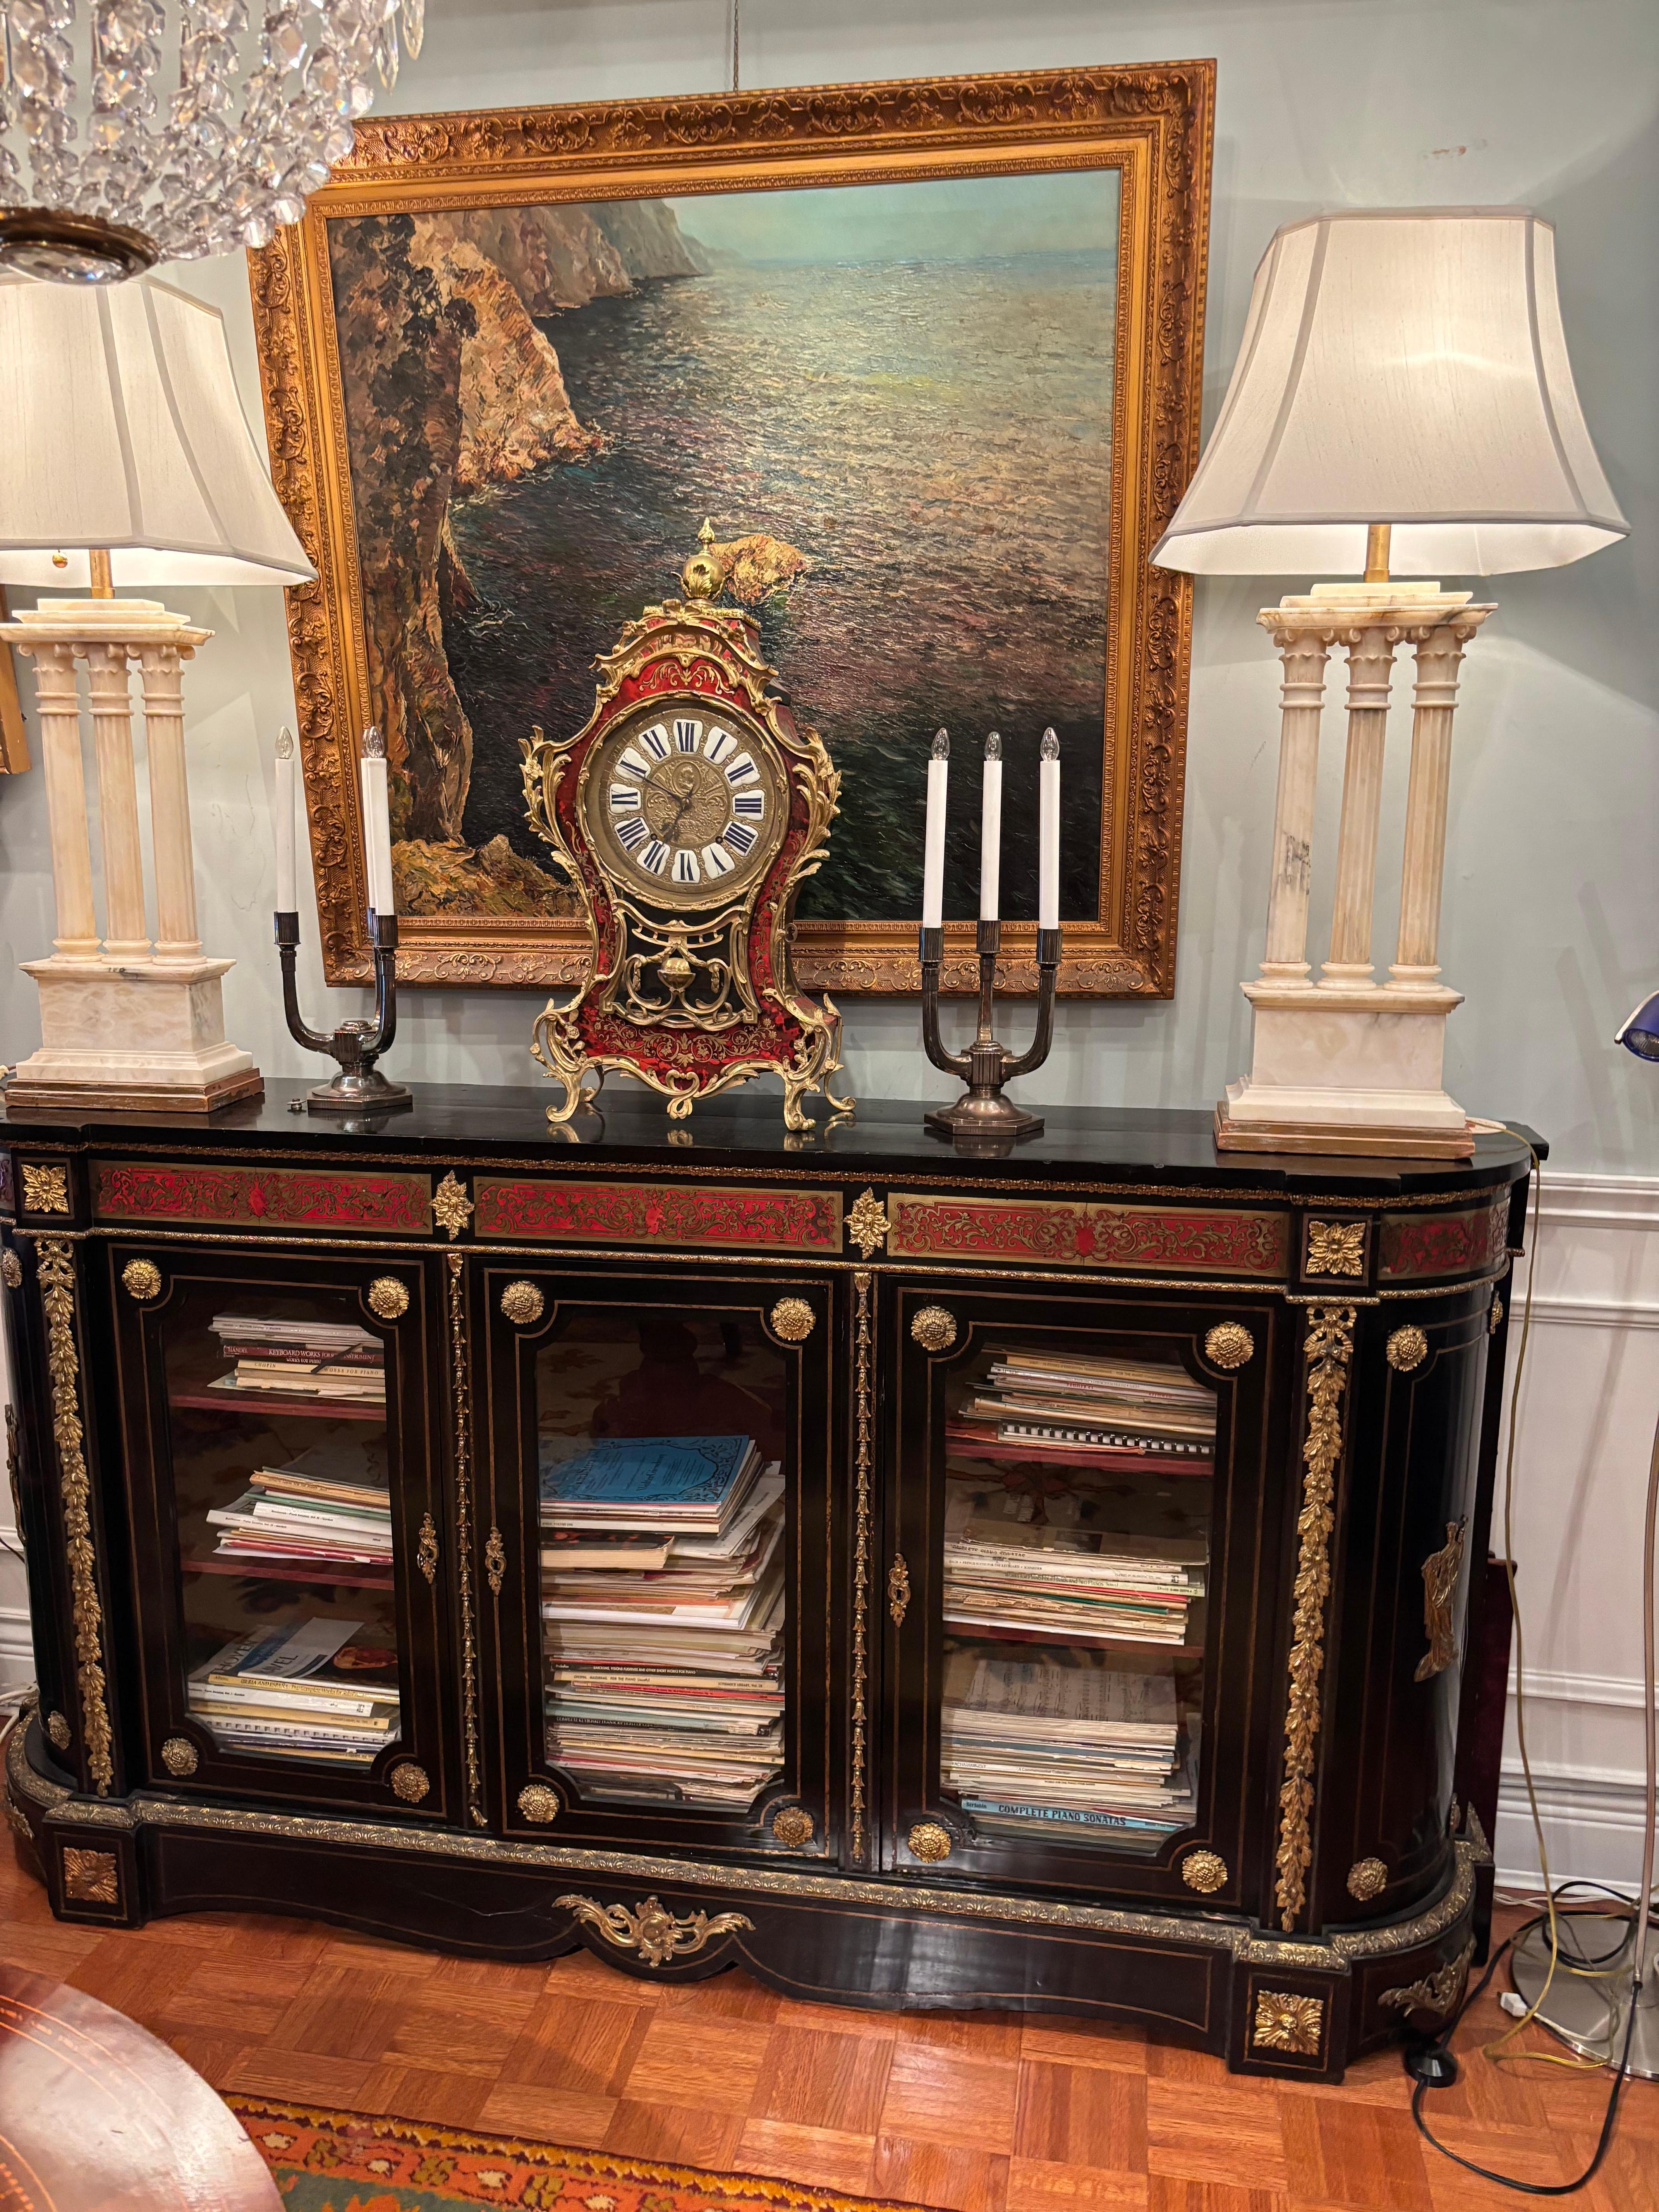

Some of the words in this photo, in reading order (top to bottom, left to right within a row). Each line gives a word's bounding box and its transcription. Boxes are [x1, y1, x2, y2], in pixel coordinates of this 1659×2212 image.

[642, 728, 669, 761] XI
[676, 721, 697, 752] XII
[709, 732, 729, 762] I
[621, 754, 649, 781] X
[726, 760, 756, 785] II
[611, 789, 638, 806] IX
[734, 795, 762, 816] III
[616, 817, 649, 851] VIII
[723, 821, 757, 856] IIII
[643, 841, 667, 875] VII
[678, 853, 696, 881] VI
[709, 846, 728, 875] V
[998, 1805, 1049, 1818] COMPLETE
[1052, 1810, 1080, 1821] PIANO
[1083, 1814, 1126, 1826] SONATAS
